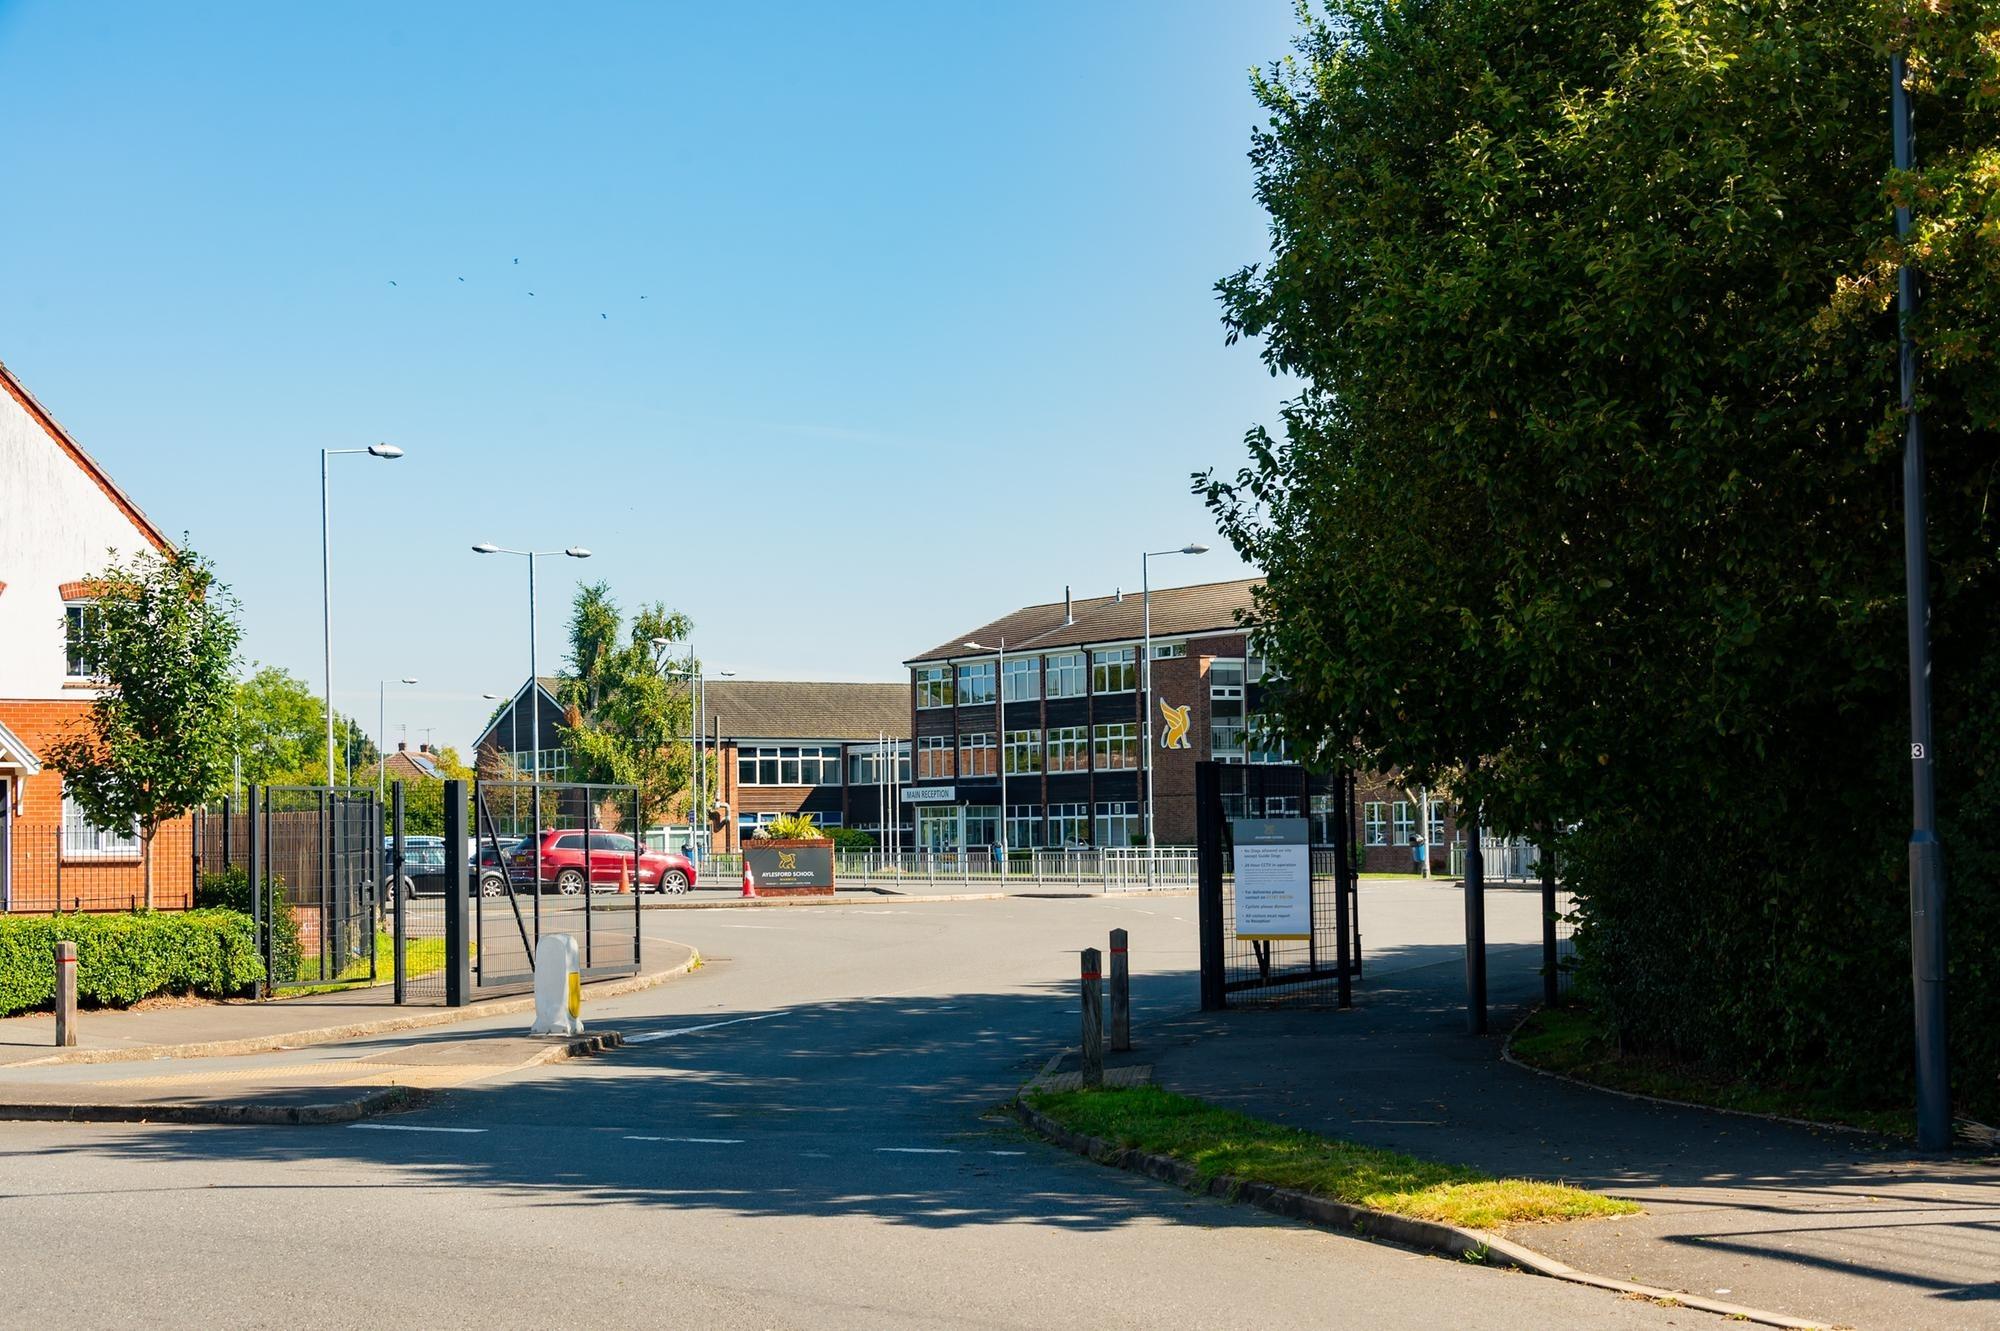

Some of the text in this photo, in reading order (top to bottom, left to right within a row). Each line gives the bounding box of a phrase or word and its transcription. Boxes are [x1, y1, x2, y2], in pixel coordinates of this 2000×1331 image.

[1913, 744, 1922, 757] 3
[906, 789, 949, 799] MAIN RECEPTION
